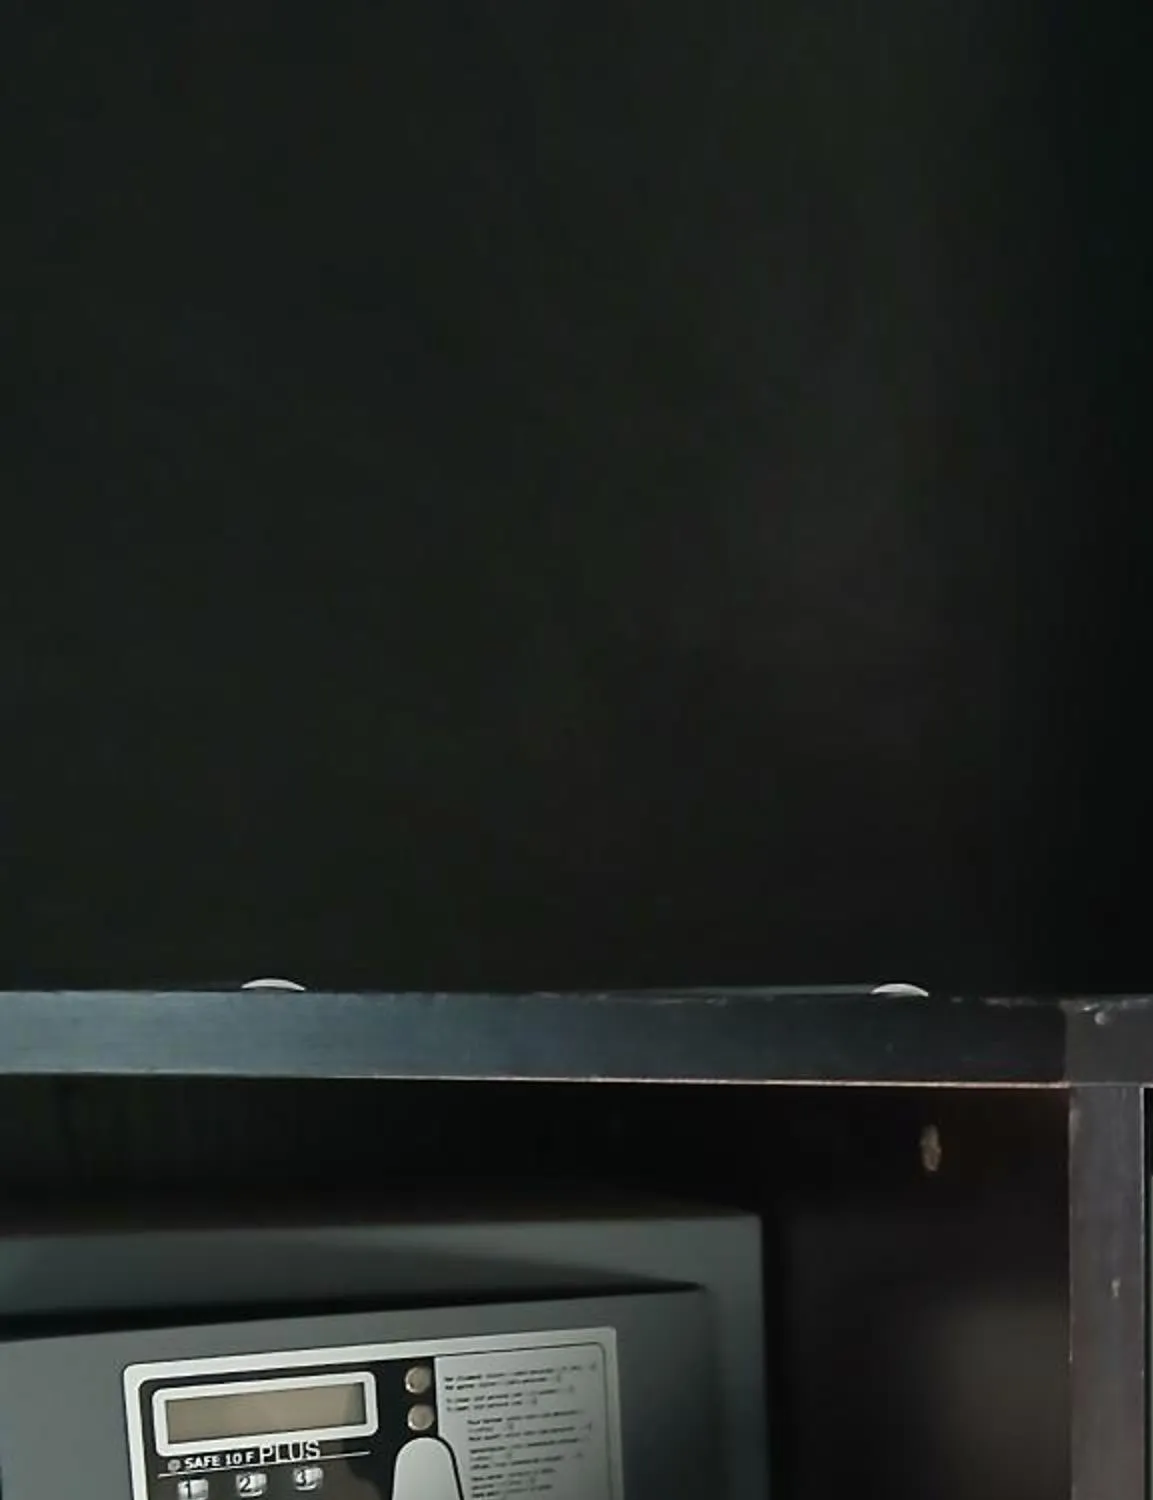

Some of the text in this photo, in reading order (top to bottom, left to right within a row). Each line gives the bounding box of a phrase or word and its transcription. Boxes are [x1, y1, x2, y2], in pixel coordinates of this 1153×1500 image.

[184, 1440, 321, 1468] SAFE 10 F PLUS
